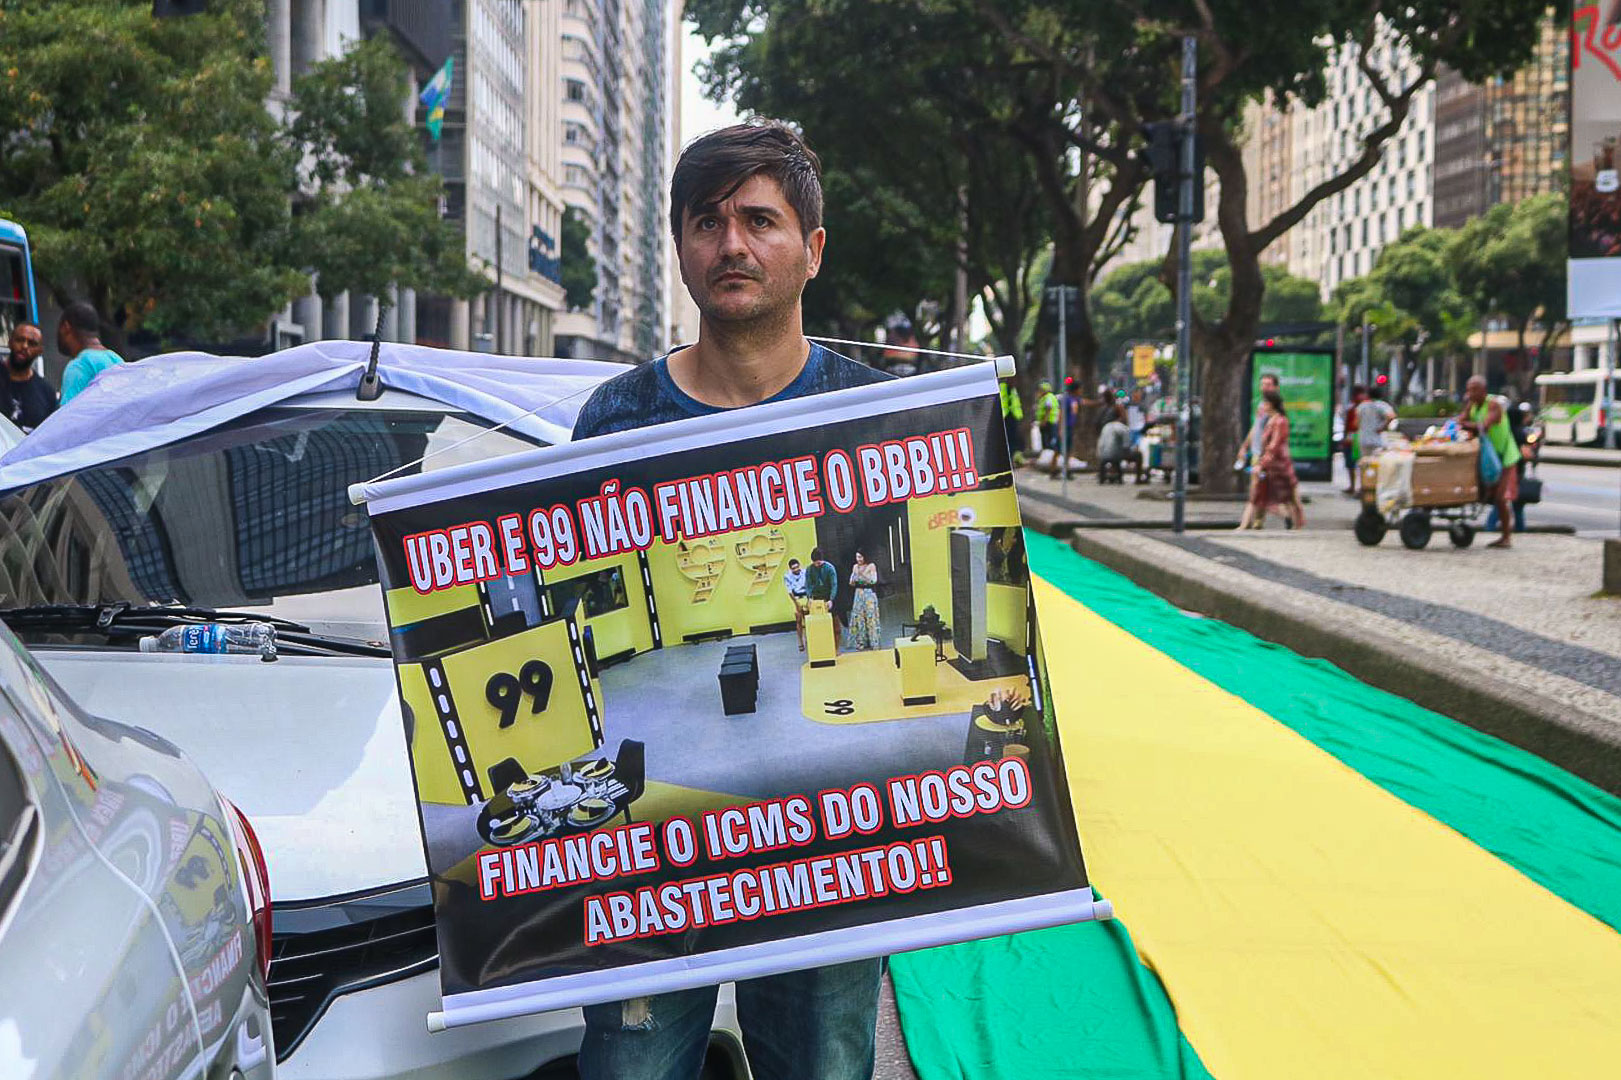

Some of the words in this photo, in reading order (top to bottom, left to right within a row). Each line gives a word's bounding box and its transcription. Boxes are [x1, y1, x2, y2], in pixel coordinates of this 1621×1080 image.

[404, 522, 499, 594] UBER
[498, 513, 531, 575] E
[529, 501, 579, 569] 99
[578, 479, 653, 560] NÃO
[654, 454, 824, 544] FINANCIE
[824, 448, 856, 513] O
[857, 428, 978, 507] BBB!!!
[485, 658, 554, 729] 99
[477, 822, 659, 899] FINANCIE
[663, 817, 697, 867] O
[704, 797, 816, 860] ICMS
[819, 783, 884, 840] DO
[888, 756, 1032, 827] NOSSO
[584, 836, 951, 945] ABASTECIMENTO!!
